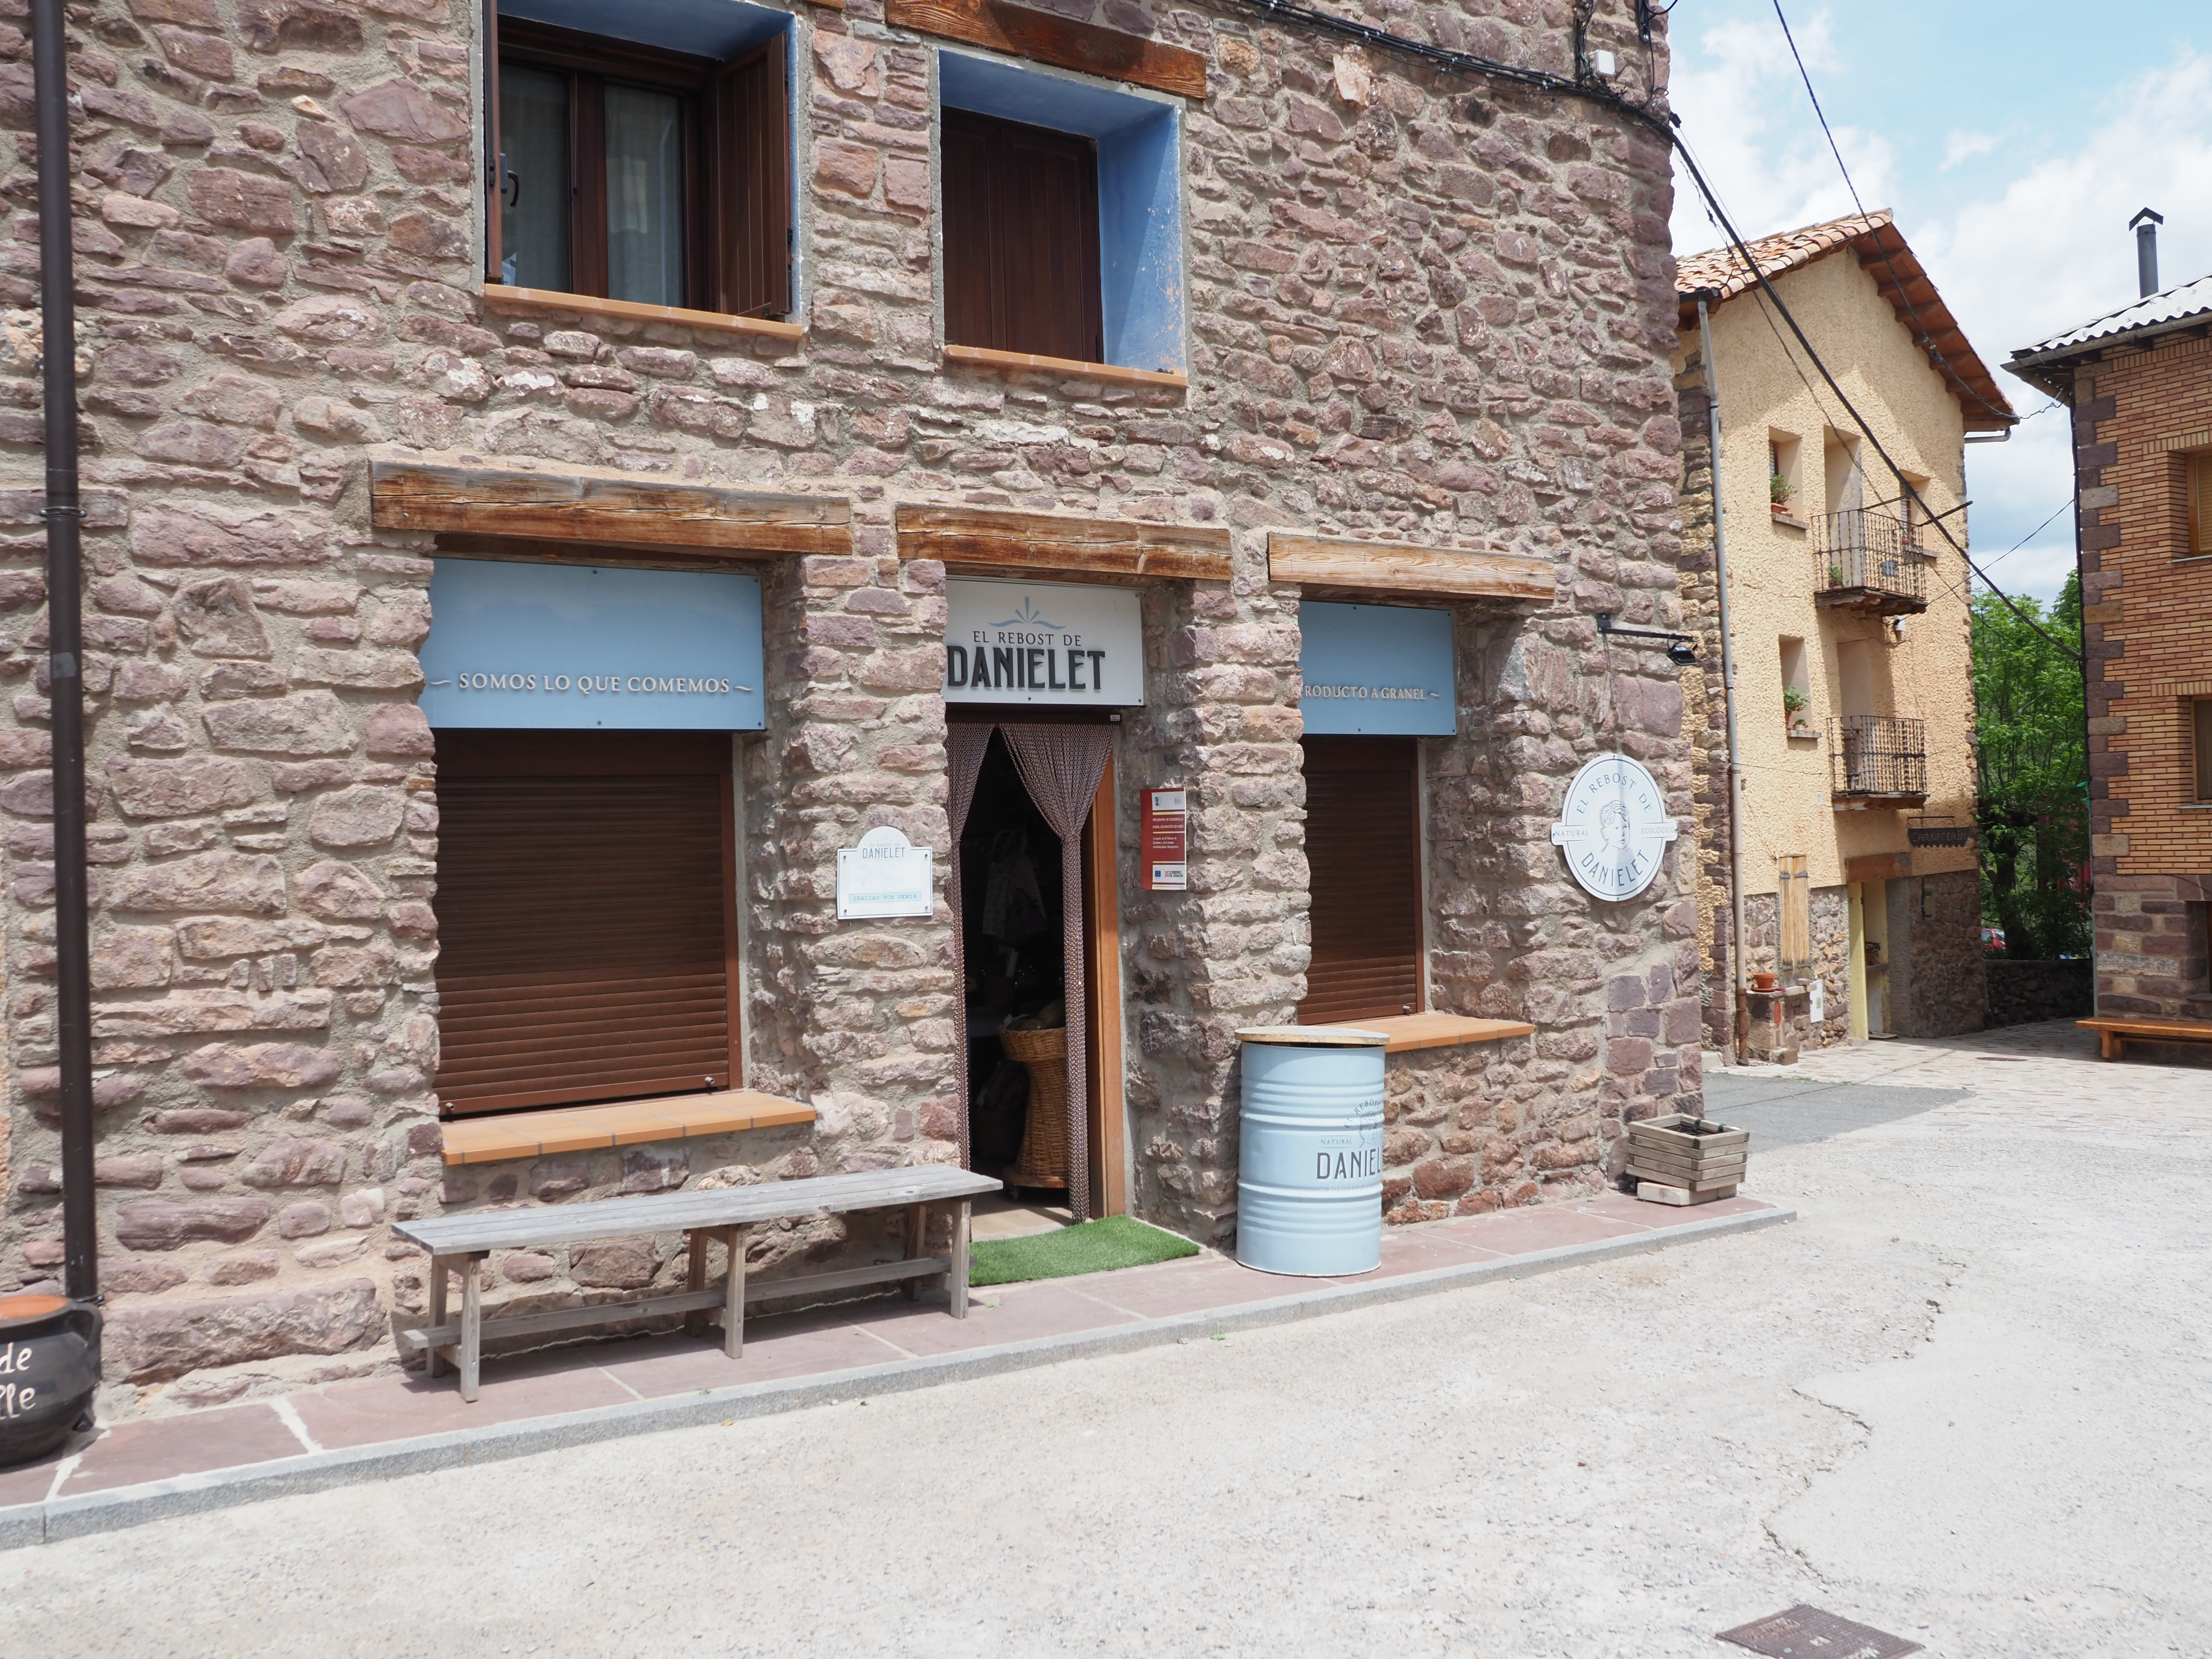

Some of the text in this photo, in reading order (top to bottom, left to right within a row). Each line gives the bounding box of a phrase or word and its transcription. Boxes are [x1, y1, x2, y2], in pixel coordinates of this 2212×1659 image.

[972, 631, 1082, 646] EL REBOST DE
[947, 645, 1106, 690] DANIELET
[459, 672, 730, 695] SOMOS LO QUE COMEMOS
[1301, 685, 1426, 700] RODUCTO A GRANEL
[1576, 773, 1653, 814] EL REBOST DE
[1555, 829, 1589, 837] NATURAL
[1641, 826, 1675, 834] ECOLÓGICO
[862, 847, 905, 859] DANIELET
[1581, 849, 1650, 887] DANIELET
